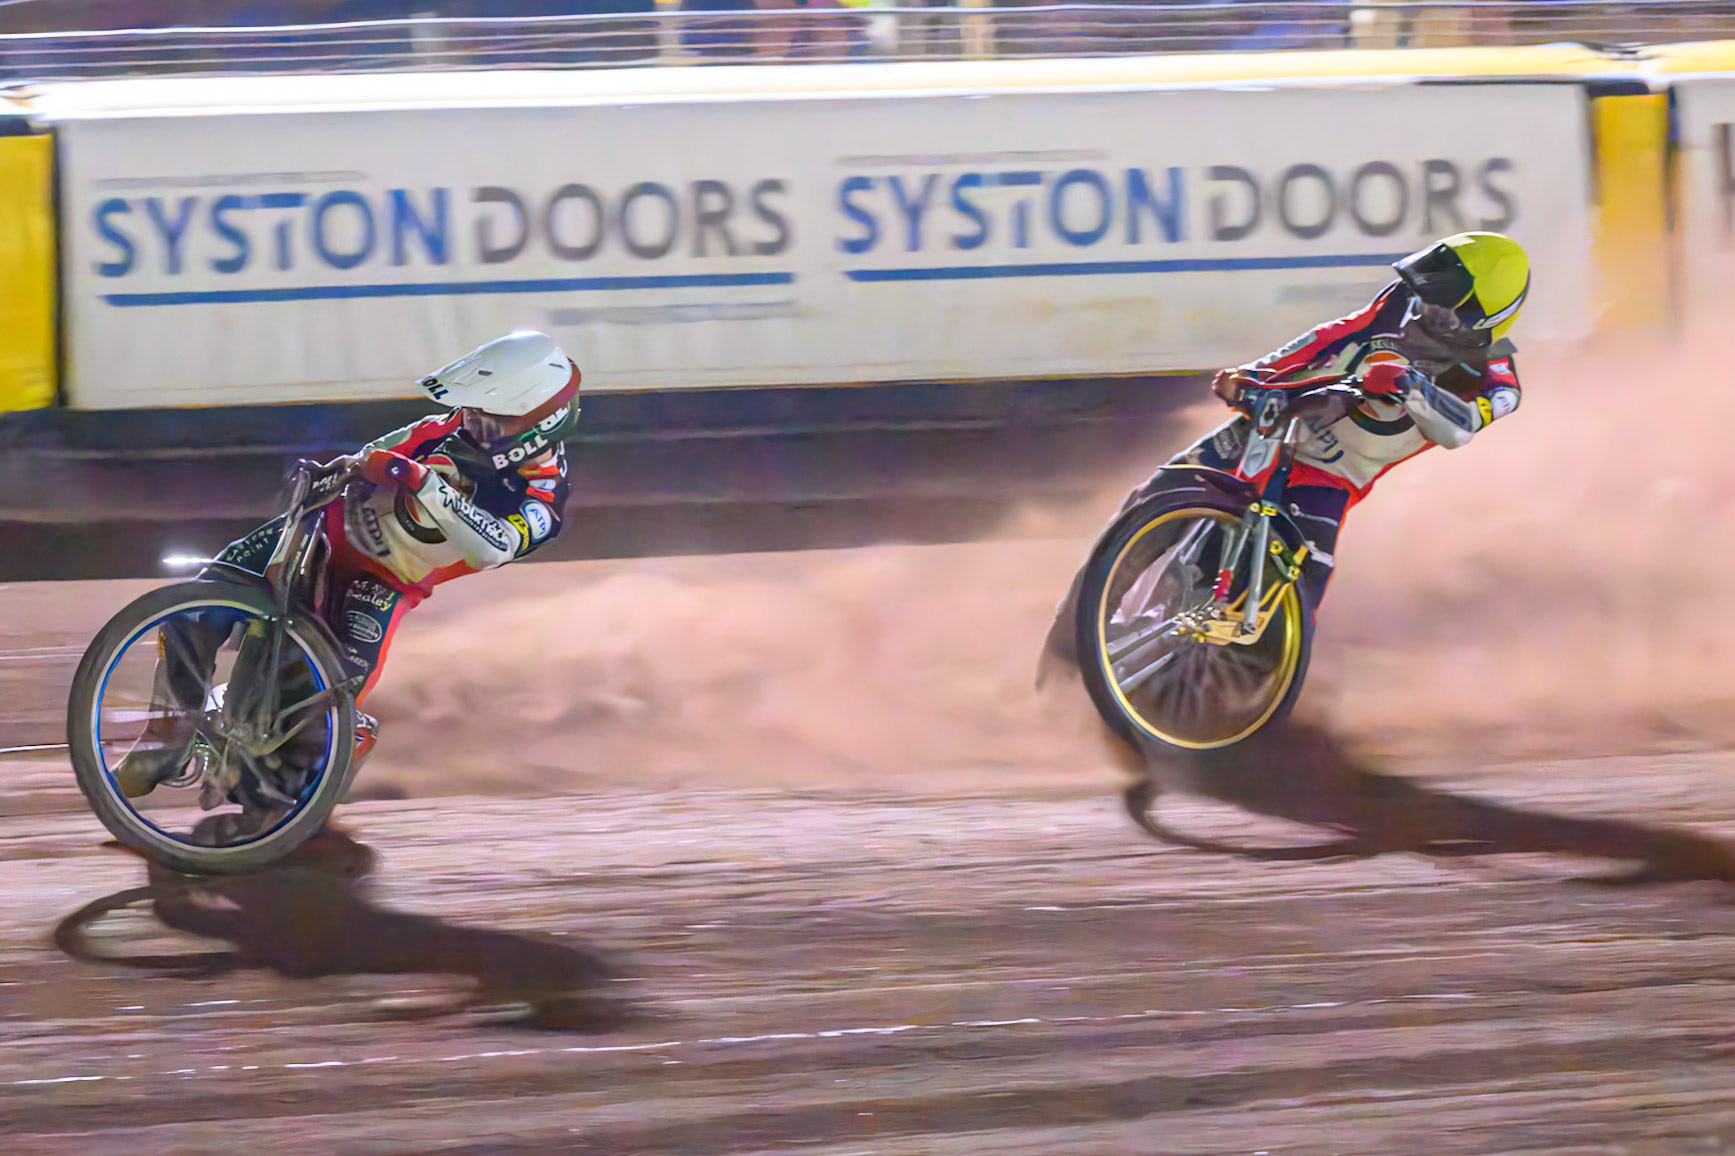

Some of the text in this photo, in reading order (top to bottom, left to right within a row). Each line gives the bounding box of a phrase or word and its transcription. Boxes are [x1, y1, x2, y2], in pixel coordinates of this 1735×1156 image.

[94, 178, 794, 277] SYSTON DOORS
[839, 157, 1517, 254] SYSTON DOORS
